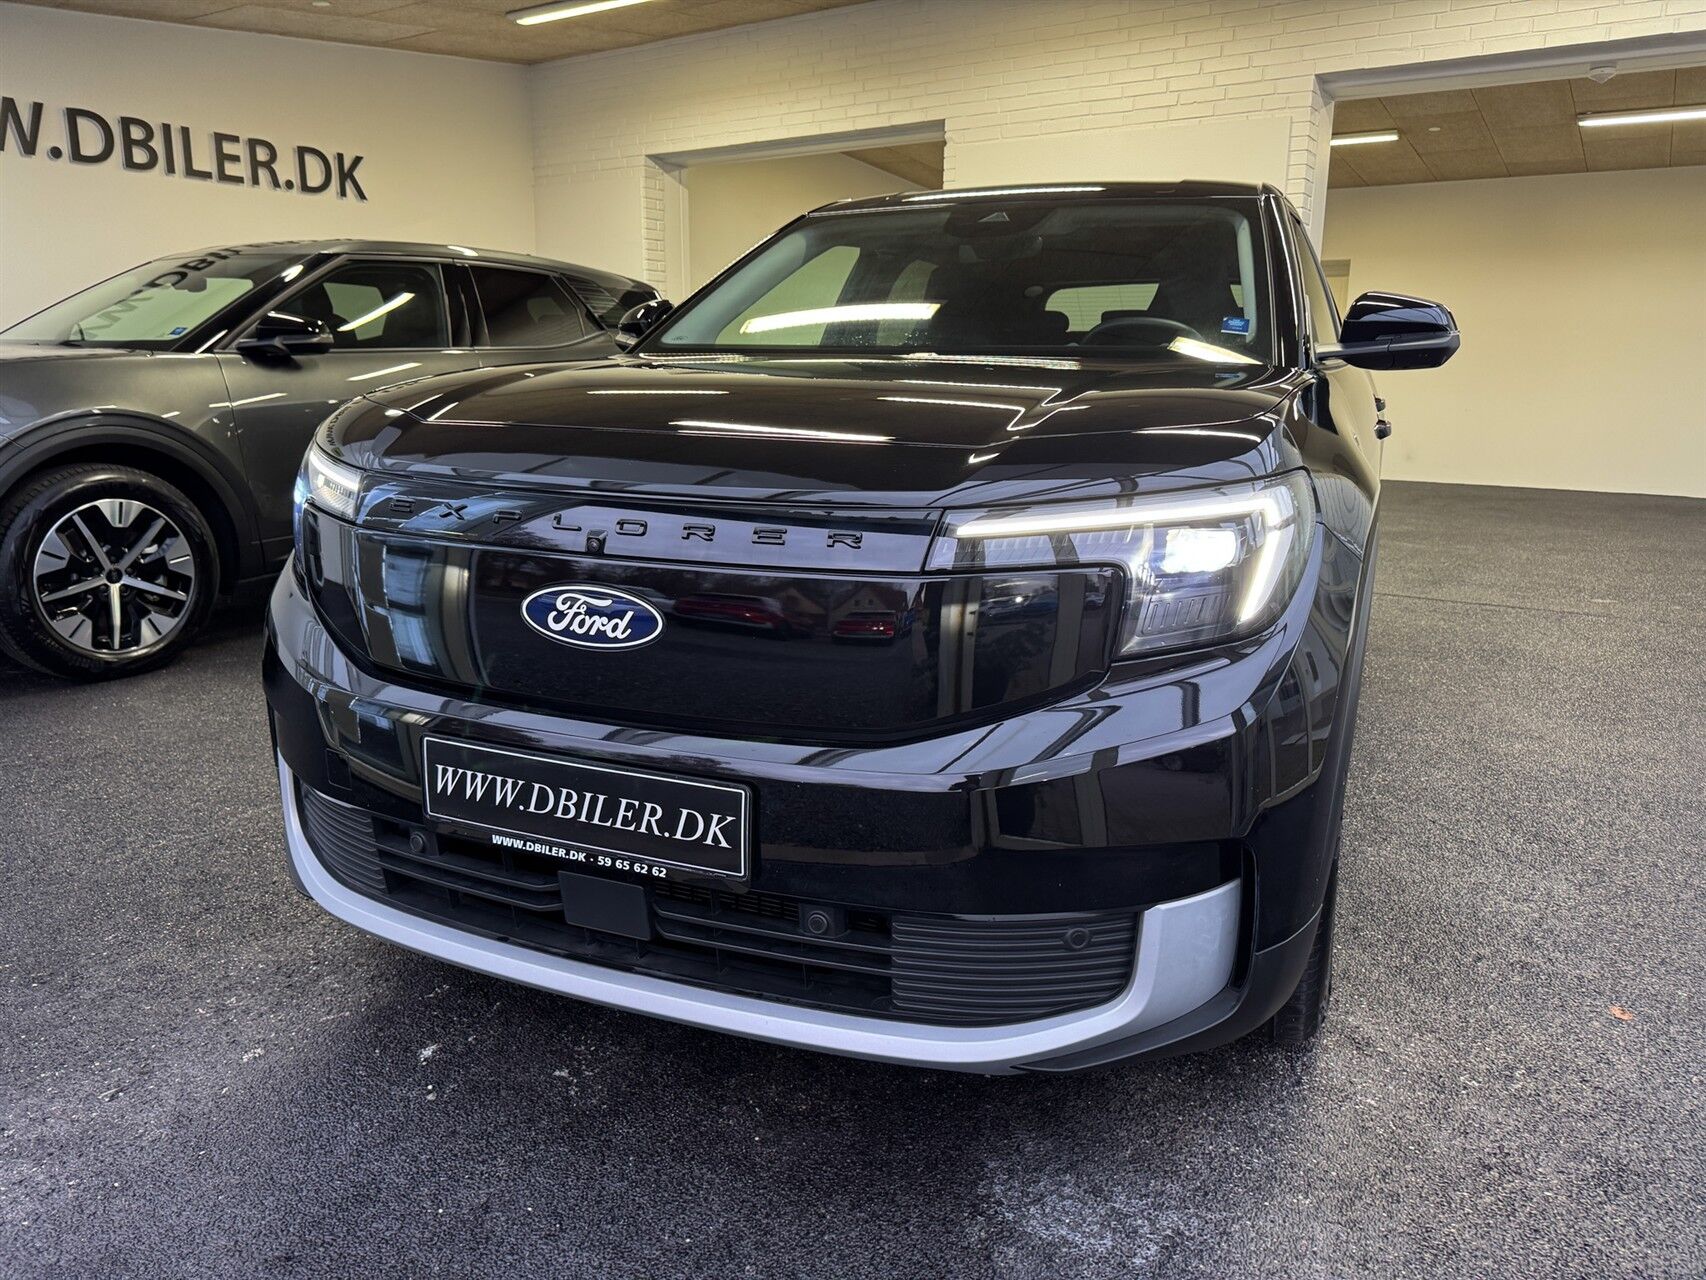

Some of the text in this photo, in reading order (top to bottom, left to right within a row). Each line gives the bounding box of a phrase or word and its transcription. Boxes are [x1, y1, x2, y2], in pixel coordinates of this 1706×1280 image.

[388, 497, 864, 549] EXPLORER
[544, 590, 638, 642] Ford
[435, 764, 735, 849] WWW.DBILER.DK
[491, 834, 667, 878] WWW.DBILER.DK 59 65 62 62
